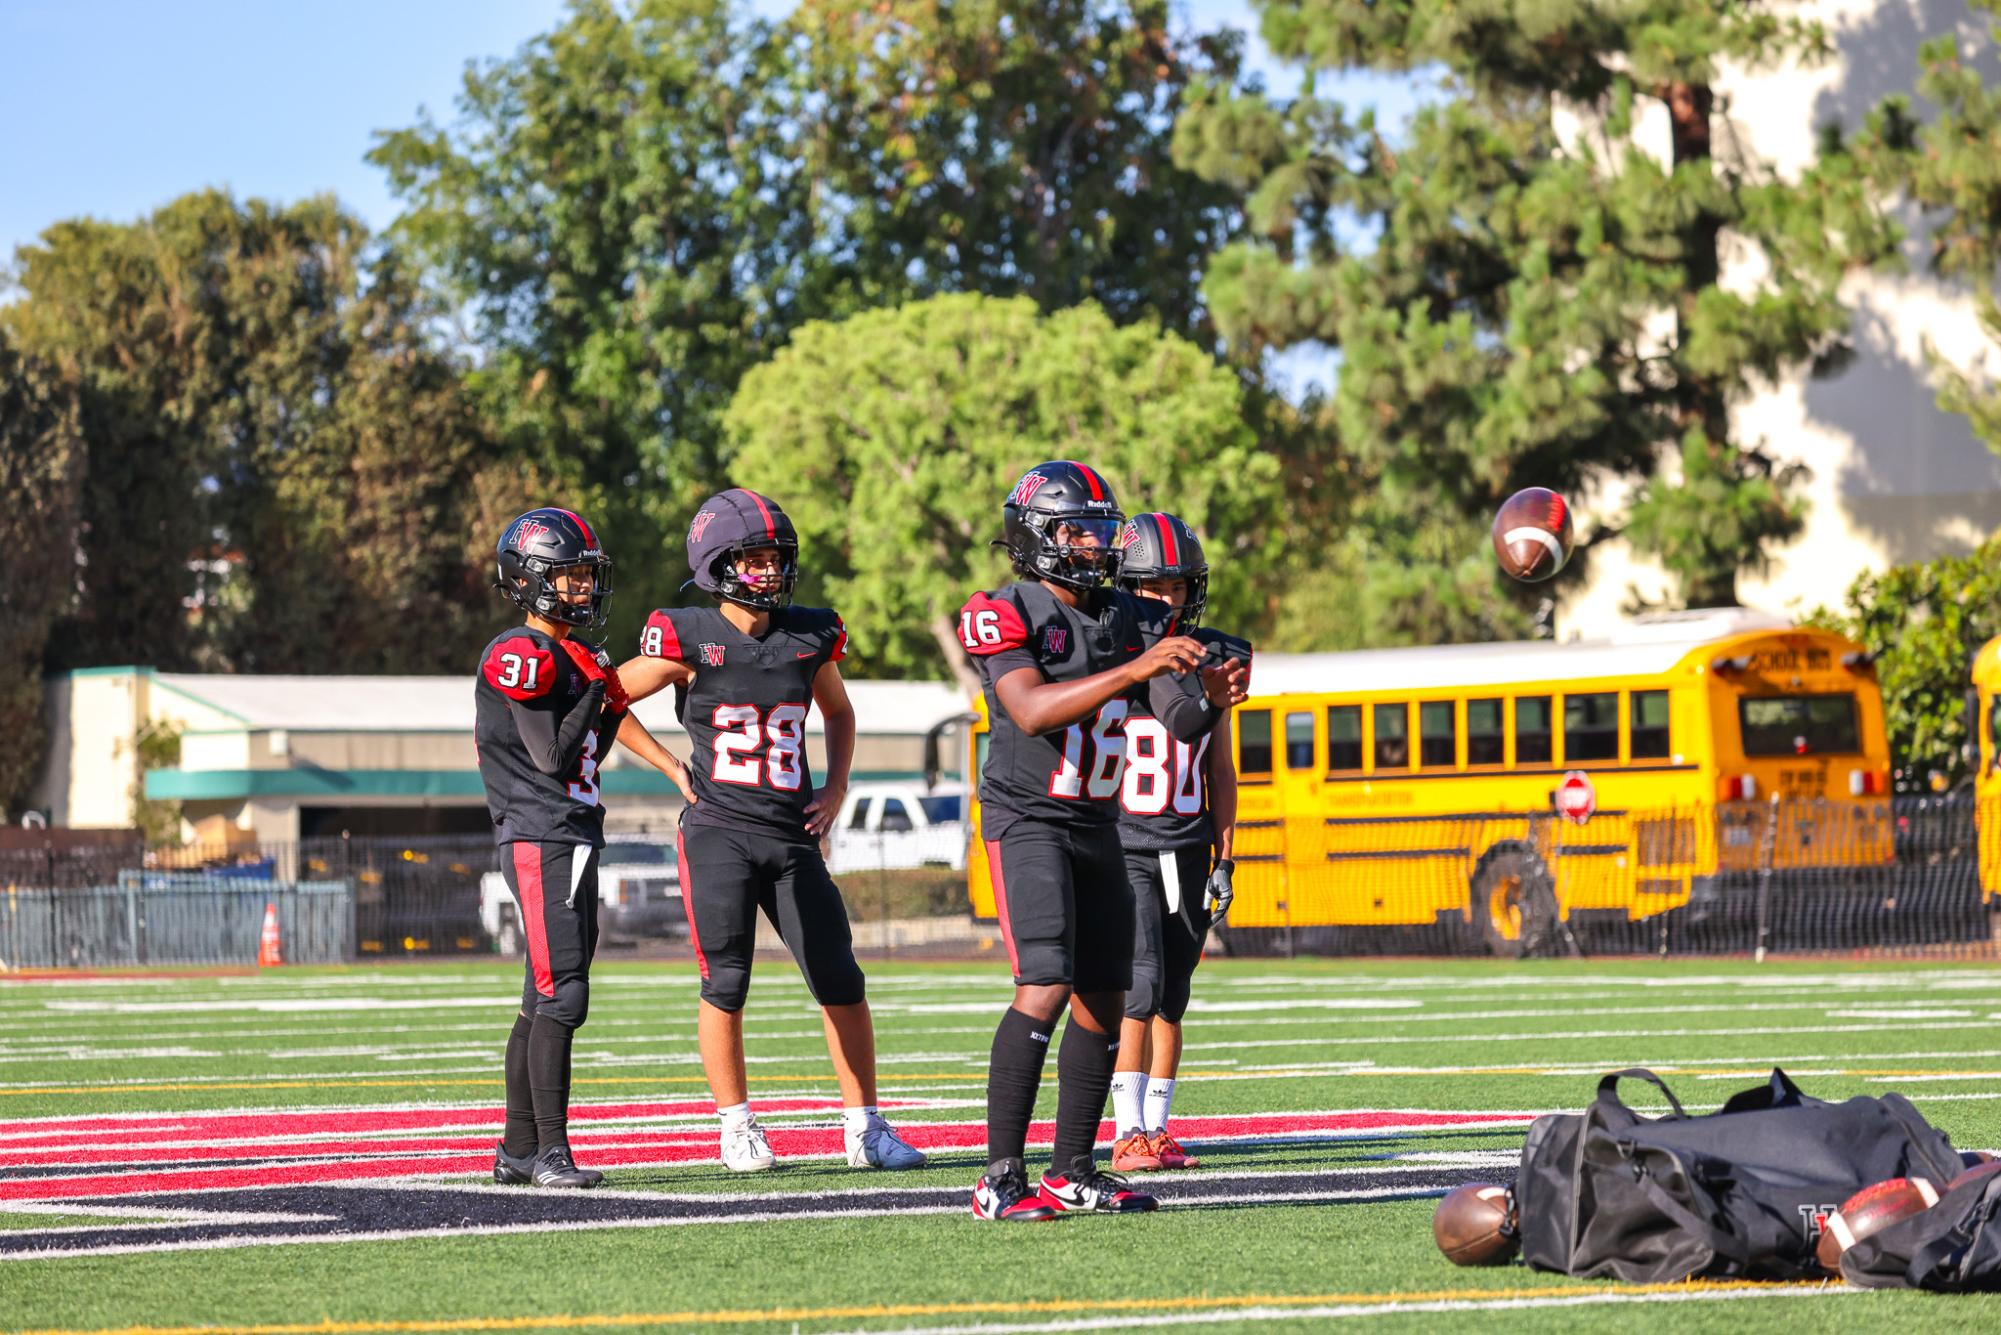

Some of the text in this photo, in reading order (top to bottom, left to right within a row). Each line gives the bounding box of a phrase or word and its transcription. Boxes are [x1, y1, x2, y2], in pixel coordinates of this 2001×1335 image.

[963, 610, 1002, 647] 16
[497, 653, 539, 689] 31
[711, 702, 809, 792] 28
[1049, 698, 1128, 799] 16
[1120, 715, 1212, 816] 80
[1798, 1203, 1838, 1252] H
